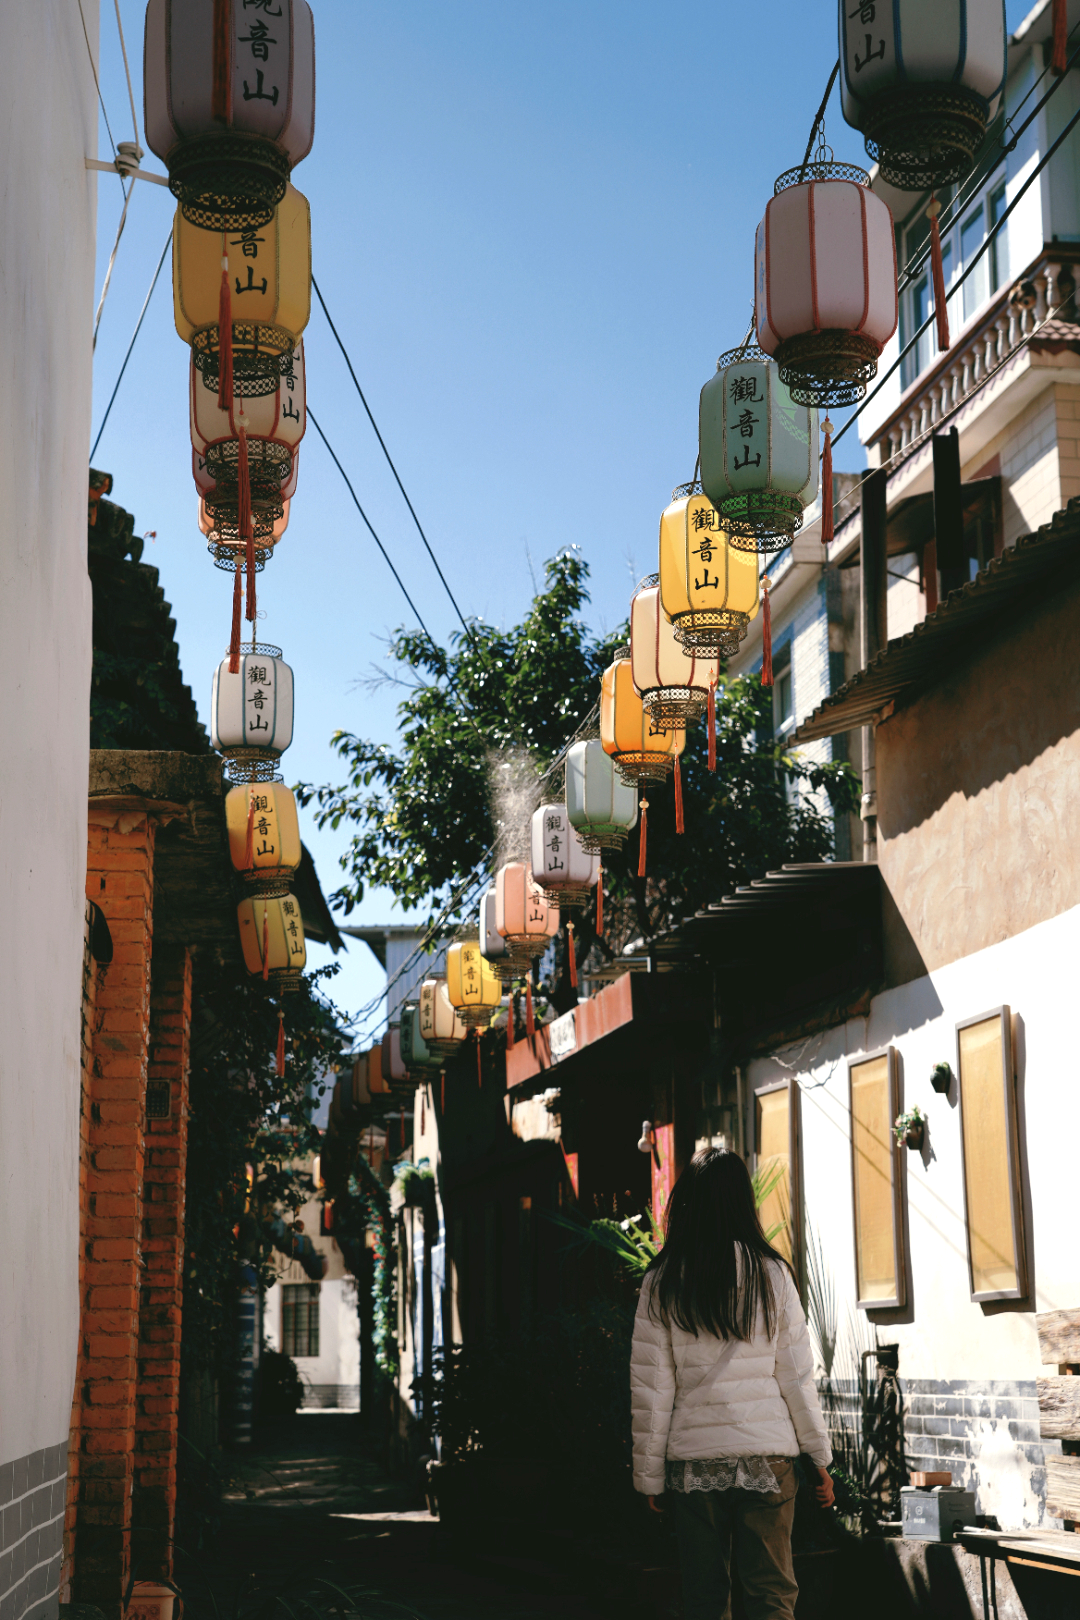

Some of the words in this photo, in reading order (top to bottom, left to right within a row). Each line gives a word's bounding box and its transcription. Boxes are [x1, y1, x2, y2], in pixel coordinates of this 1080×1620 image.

[729, 376, 764, 470] 觀音山
[691, 507, 721, 591] 觀音山
[247, 665, 271, 731] 觀音山
[252, 795, 275, 856] 觀音山
[545, 815, 565, 871] 觀音山
[282, 901, 303, 955] 觀音山
[463, 950, 479, 996] 觀音山
